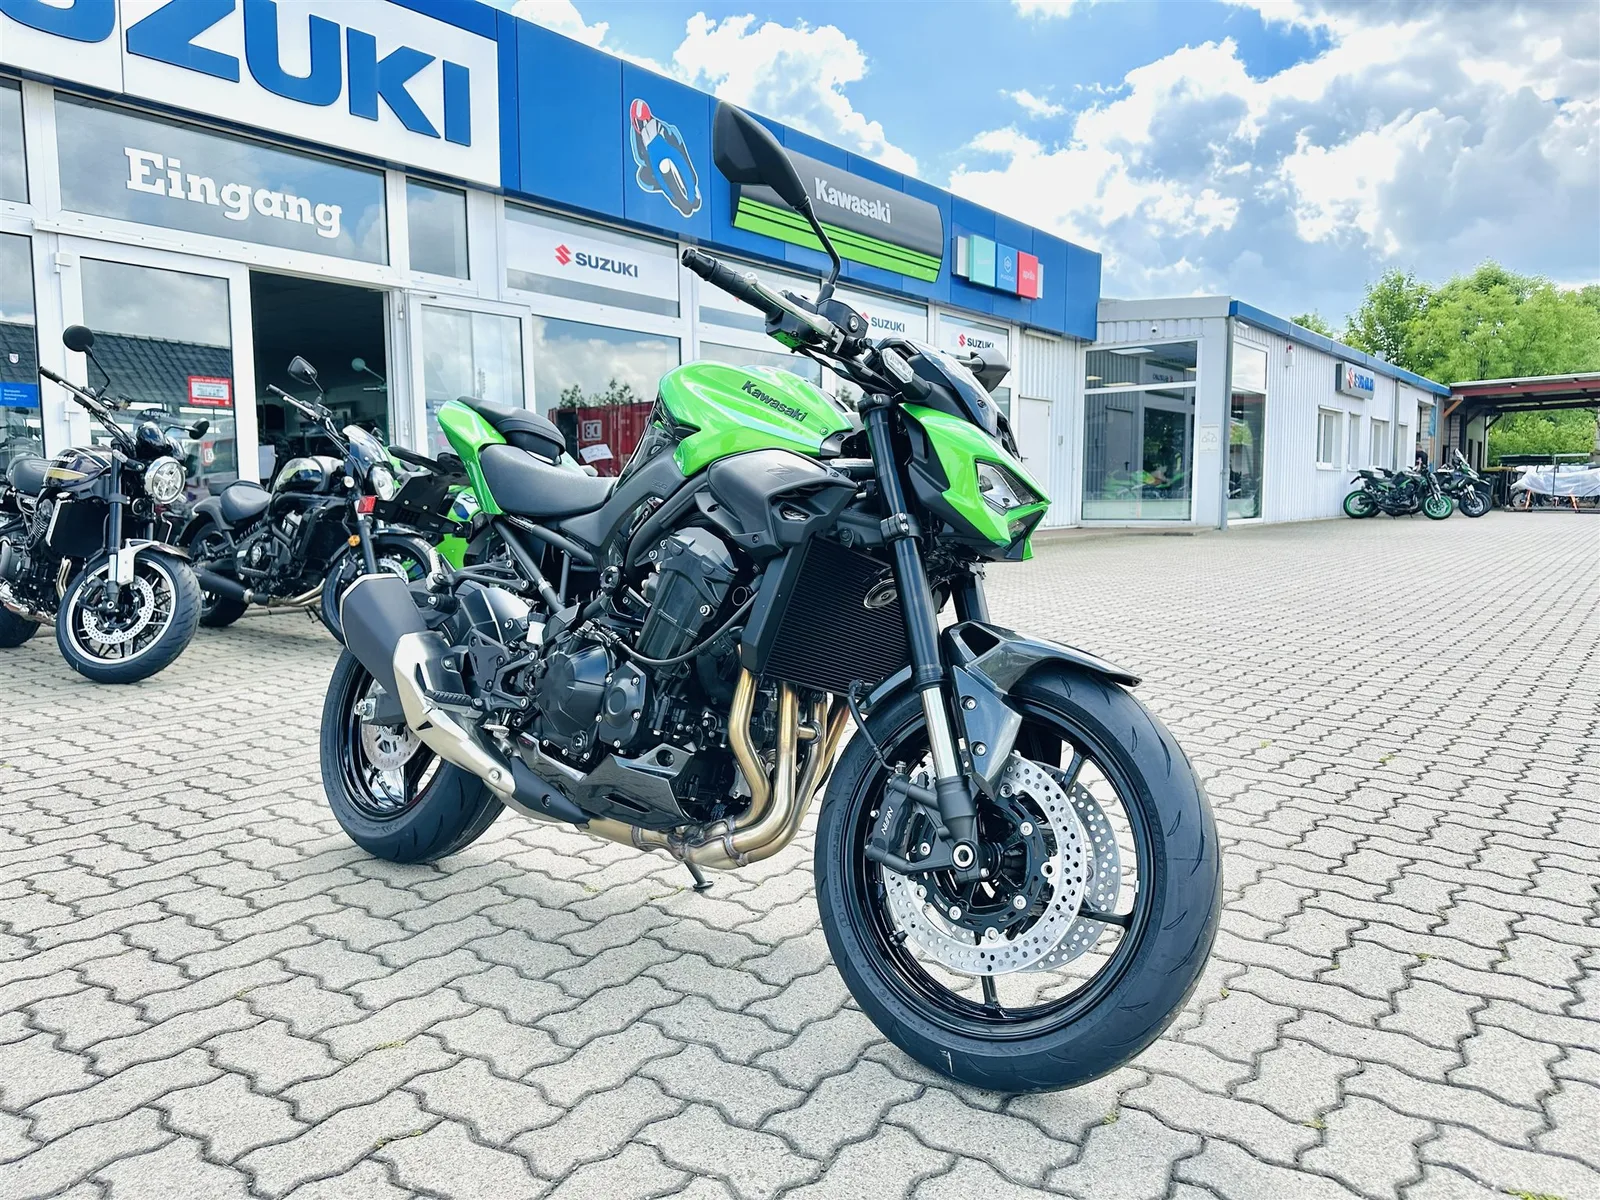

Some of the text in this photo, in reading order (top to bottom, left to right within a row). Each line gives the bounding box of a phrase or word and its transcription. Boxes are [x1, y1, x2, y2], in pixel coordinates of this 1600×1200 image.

[123, 146, 343, 239] Eingang
[814, 177, 892, 224] Kawasaki
[575, 252, 639, 278] SUZUKI
[870, 316, 906, 333] SUZUKI
[741, 380, 808, 422] Kawasaki
